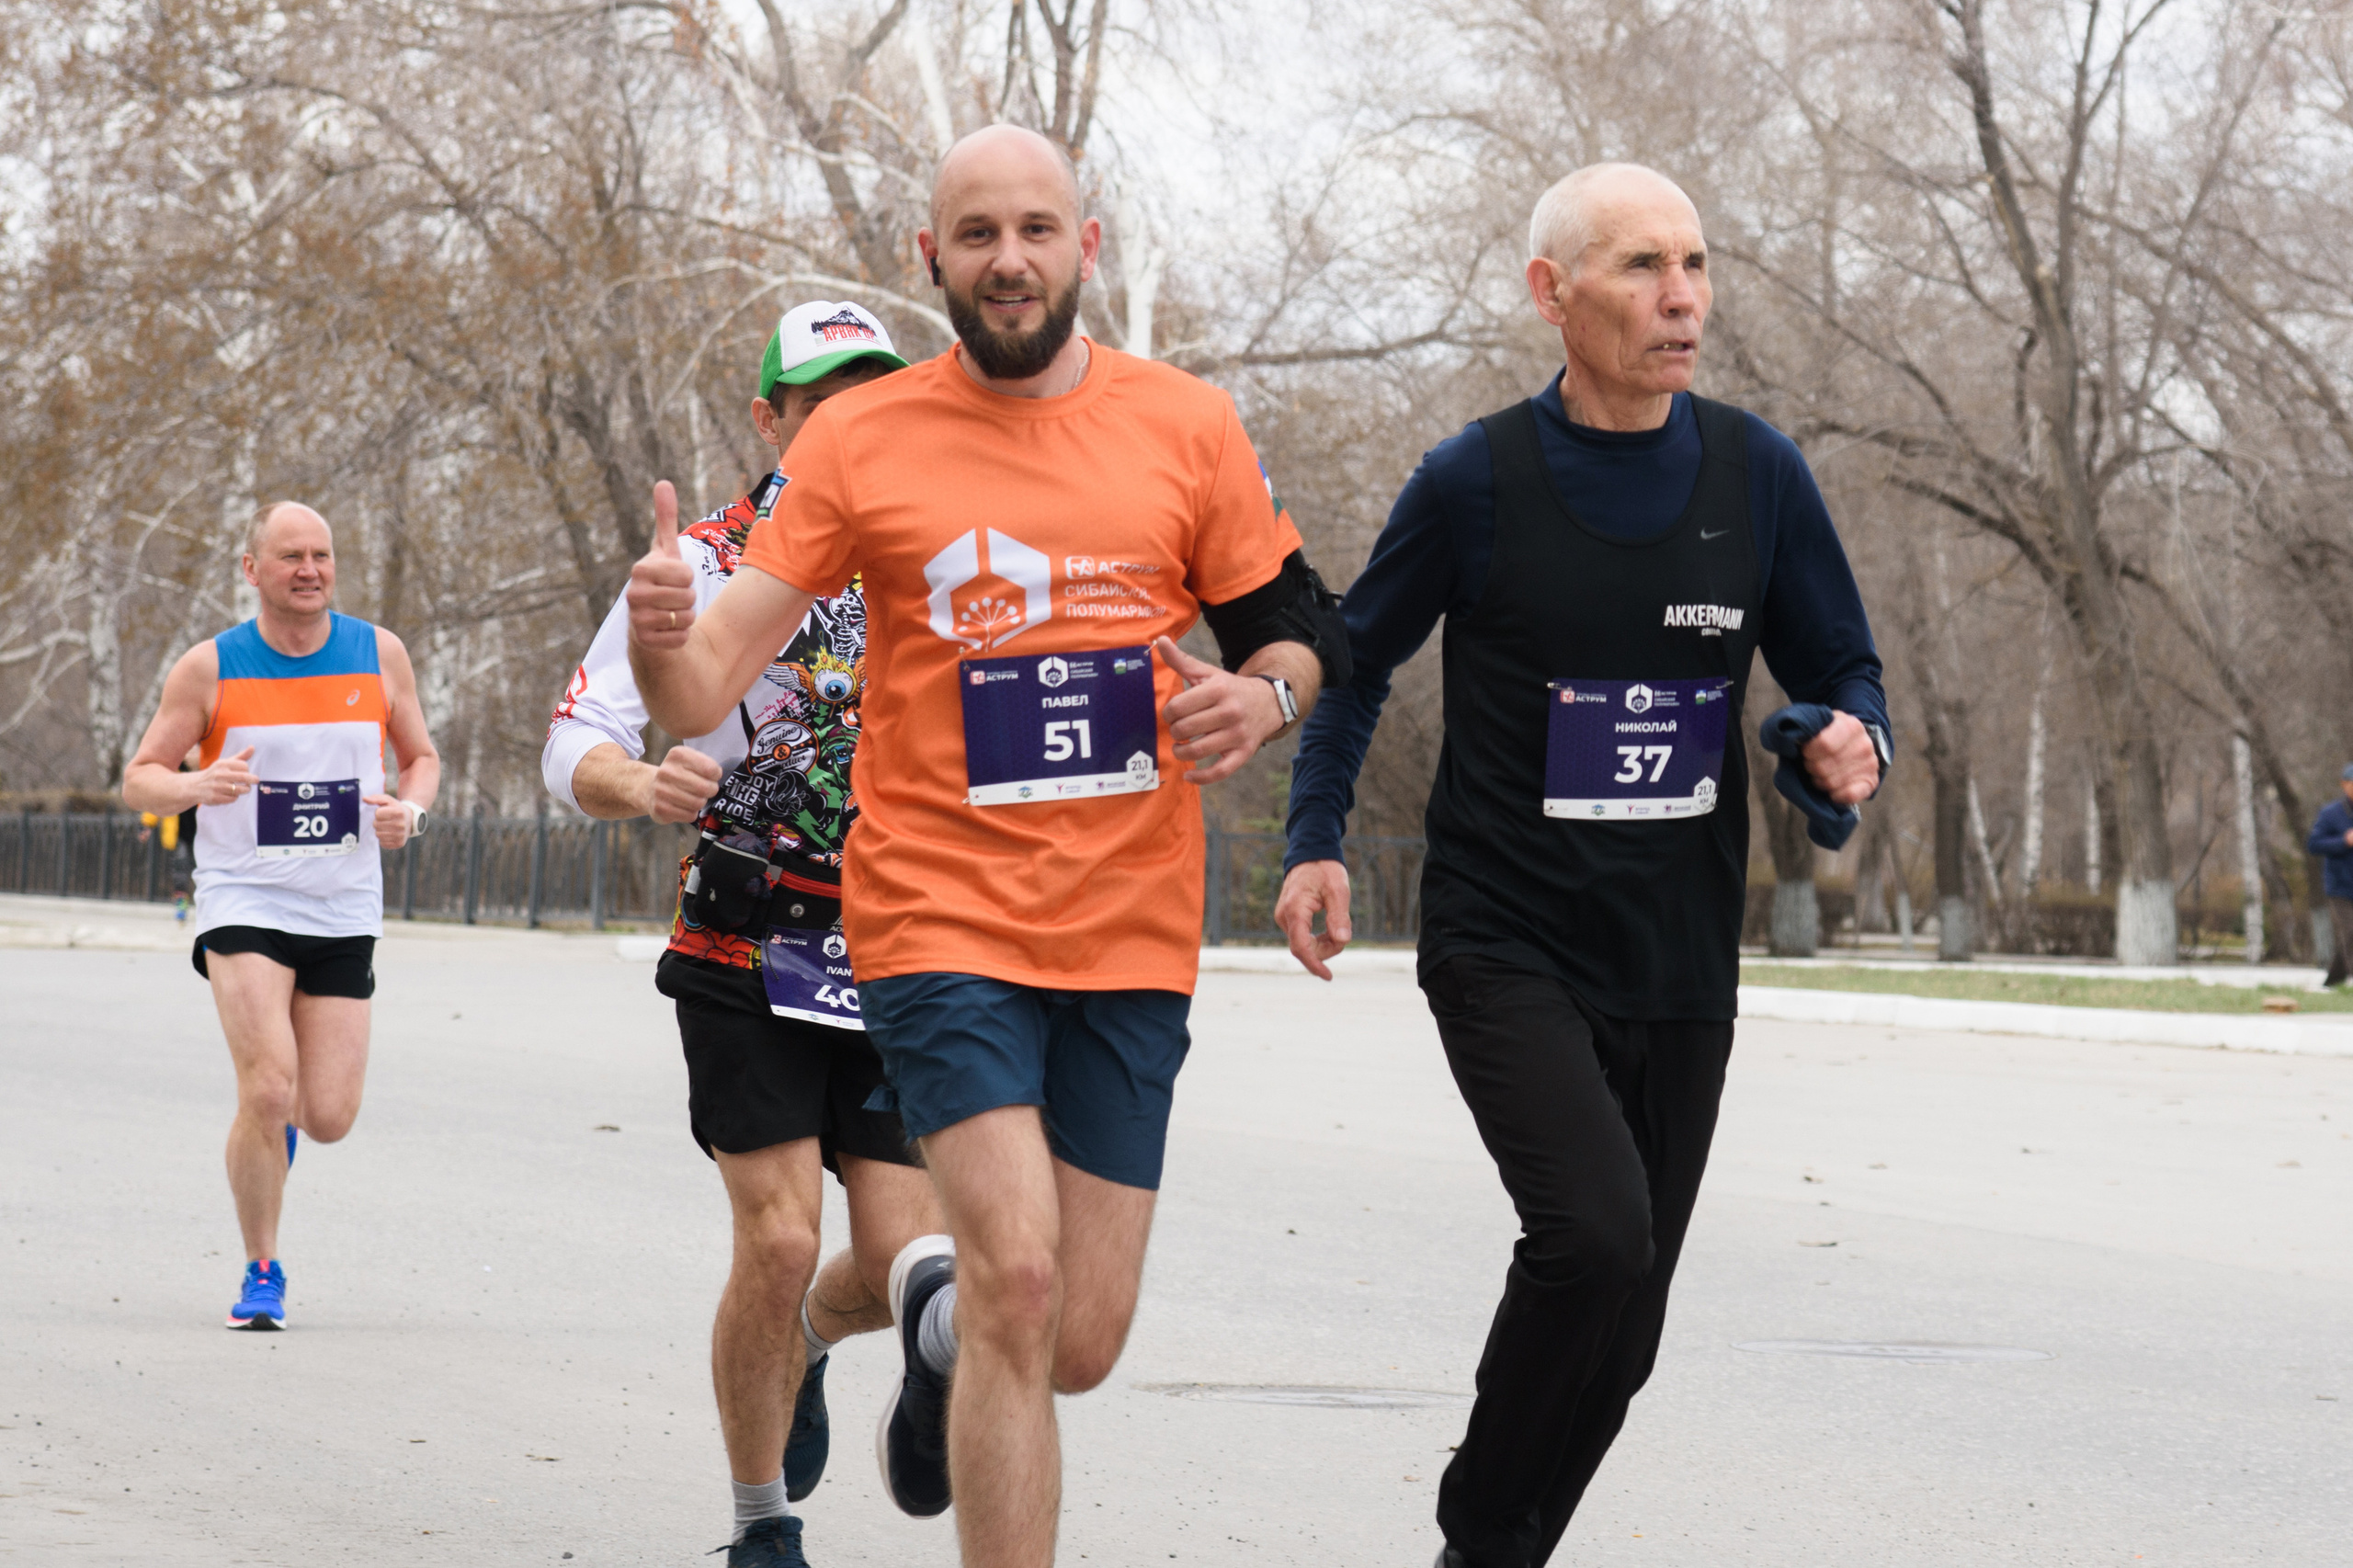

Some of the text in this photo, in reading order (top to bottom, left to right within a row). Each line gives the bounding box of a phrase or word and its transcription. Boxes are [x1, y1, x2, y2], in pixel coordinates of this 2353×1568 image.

[1664, 604, 1745, 631] AKKERMANN
[1041, 695, 1089, 709] ПАВЕЛ
[1615, 719, 1677, 733] НИКОЛАЙ
[1043, 719, 1092, 762] 51
[1131, 759, 1149, 772] 21,1
[1614, 745, 1673, 783] 37
[714, 798, 754, 822] RIDE
[293, 815, 329, 838] 20
[826, 965, 852, 977] IVAN
